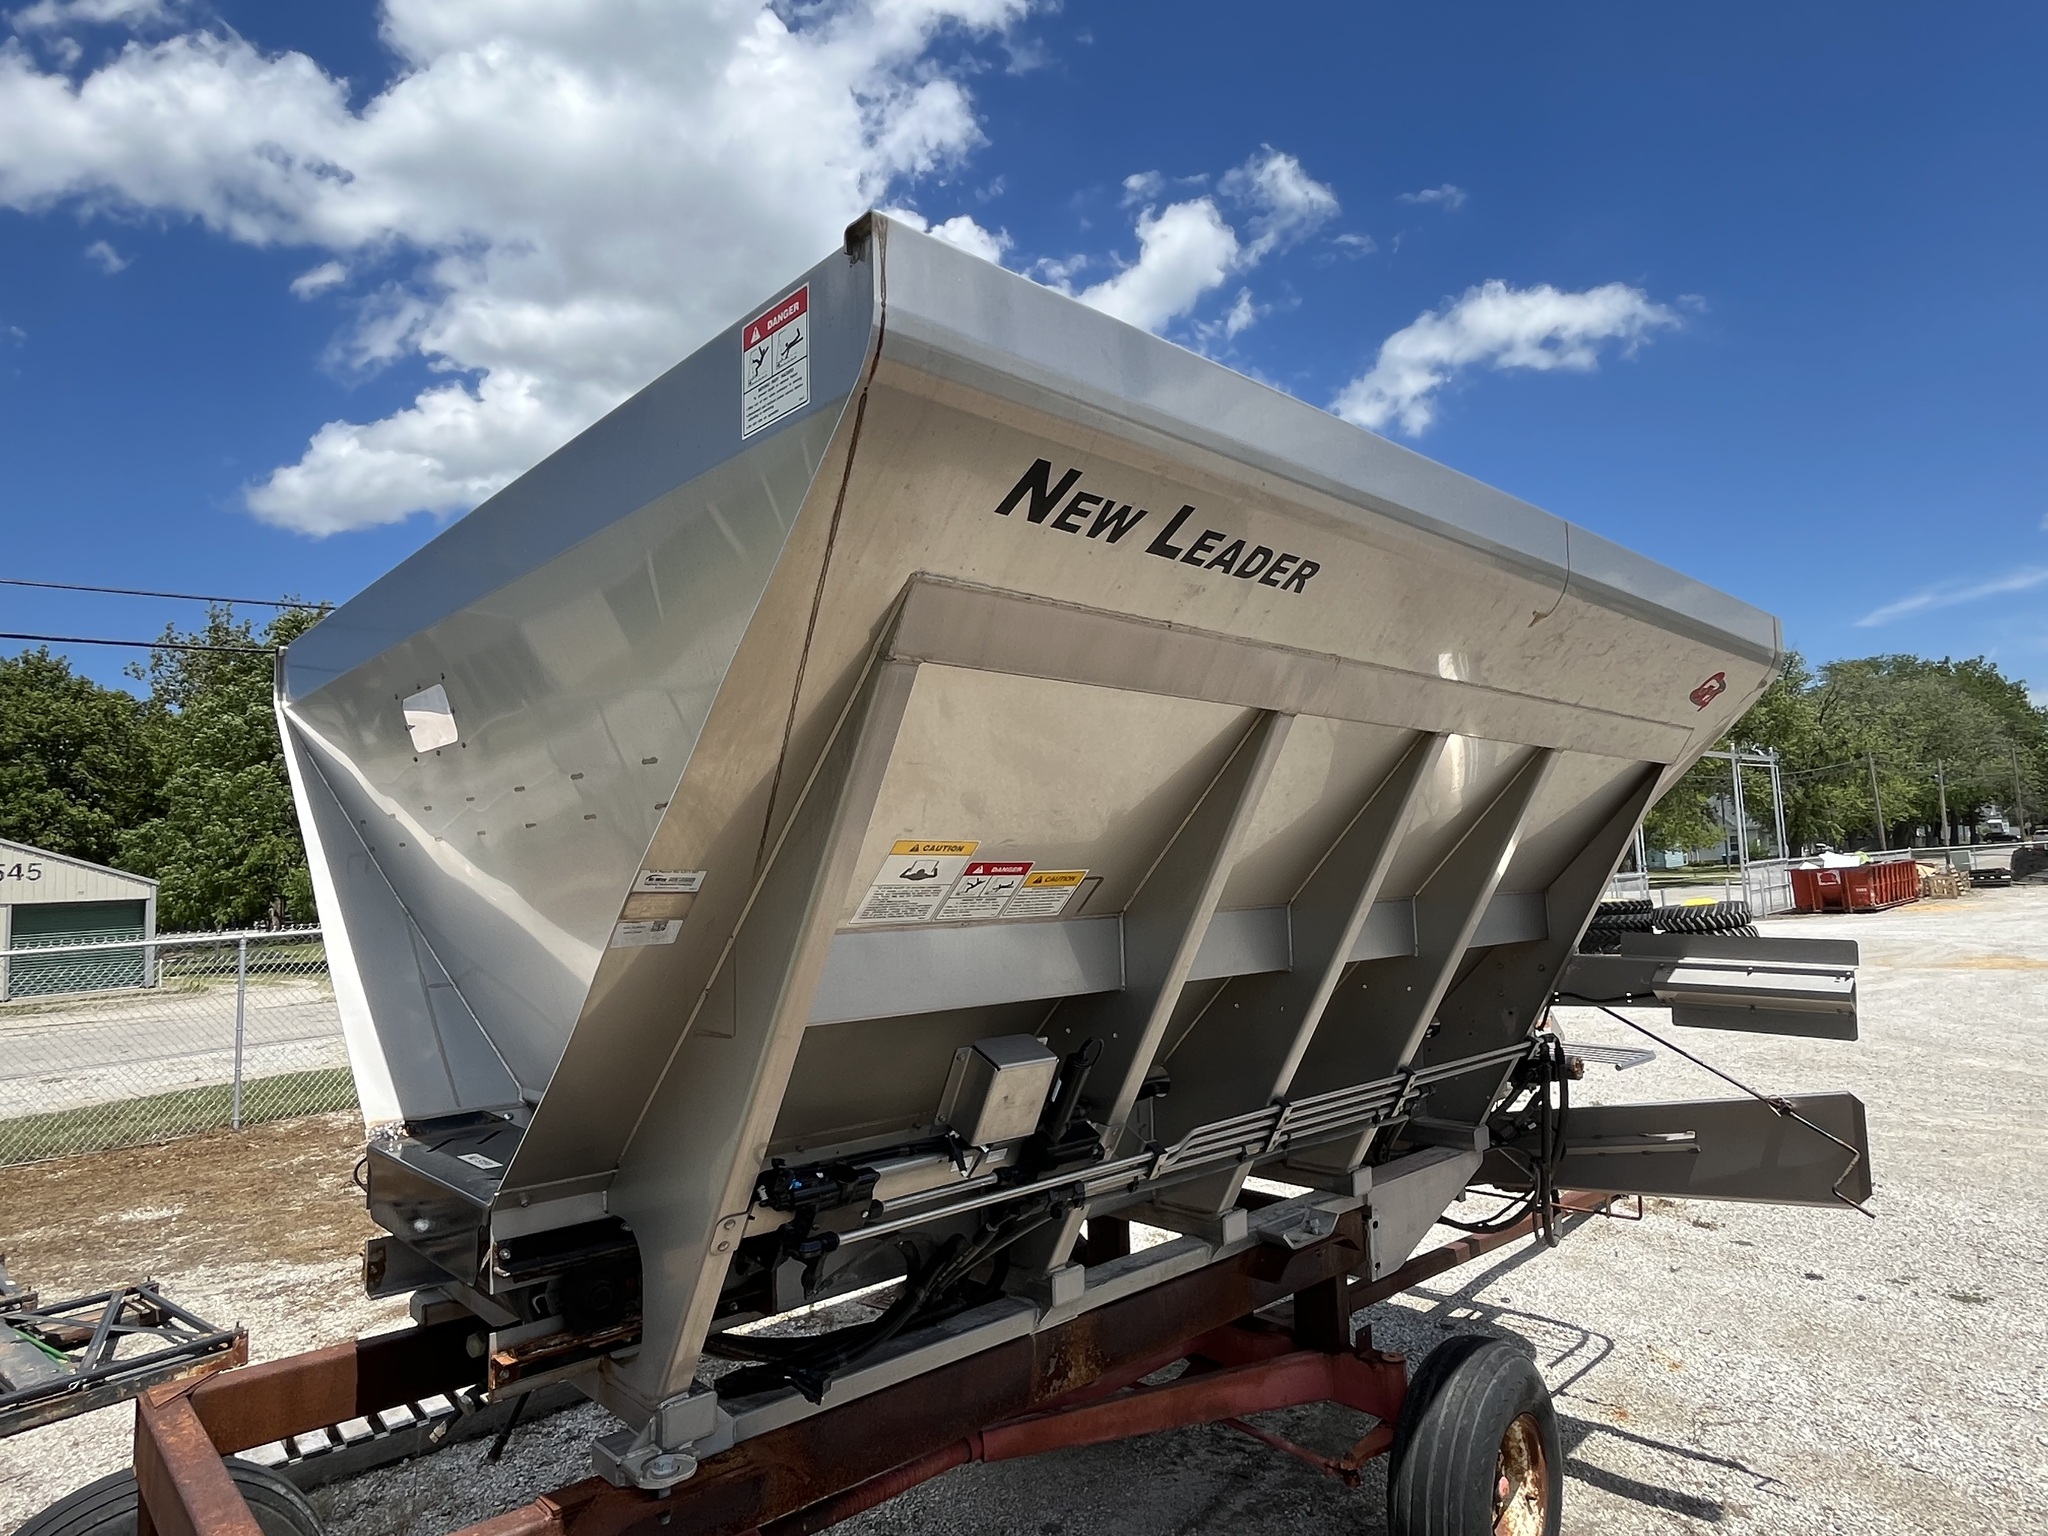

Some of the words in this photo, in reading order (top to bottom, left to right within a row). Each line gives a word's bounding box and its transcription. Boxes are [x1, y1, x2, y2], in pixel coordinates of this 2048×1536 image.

[767, 301, 800, 331] DANGER
[994, 458, 1149, 544] NEW
[1145, 504, 1321, 594] LEADER
[922, 844, 965, 853] CAUTION
